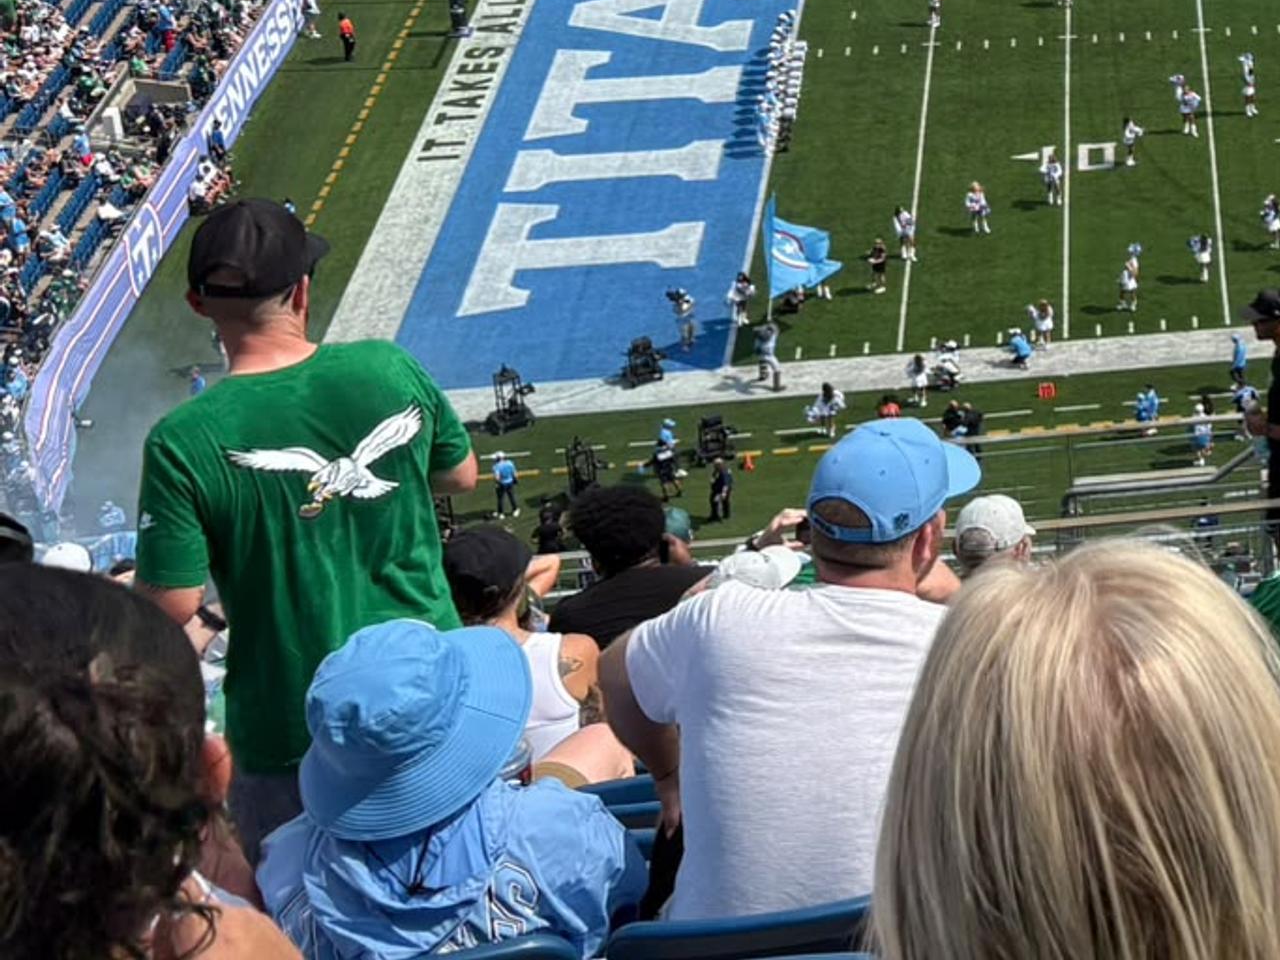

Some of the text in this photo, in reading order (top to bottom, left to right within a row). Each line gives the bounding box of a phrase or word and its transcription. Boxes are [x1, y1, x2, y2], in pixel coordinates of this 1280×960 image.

[436, 45, 506, 126] TAKES
[417, 138, 465, 161] IT
[1039, 142, 1117, 172] 10
